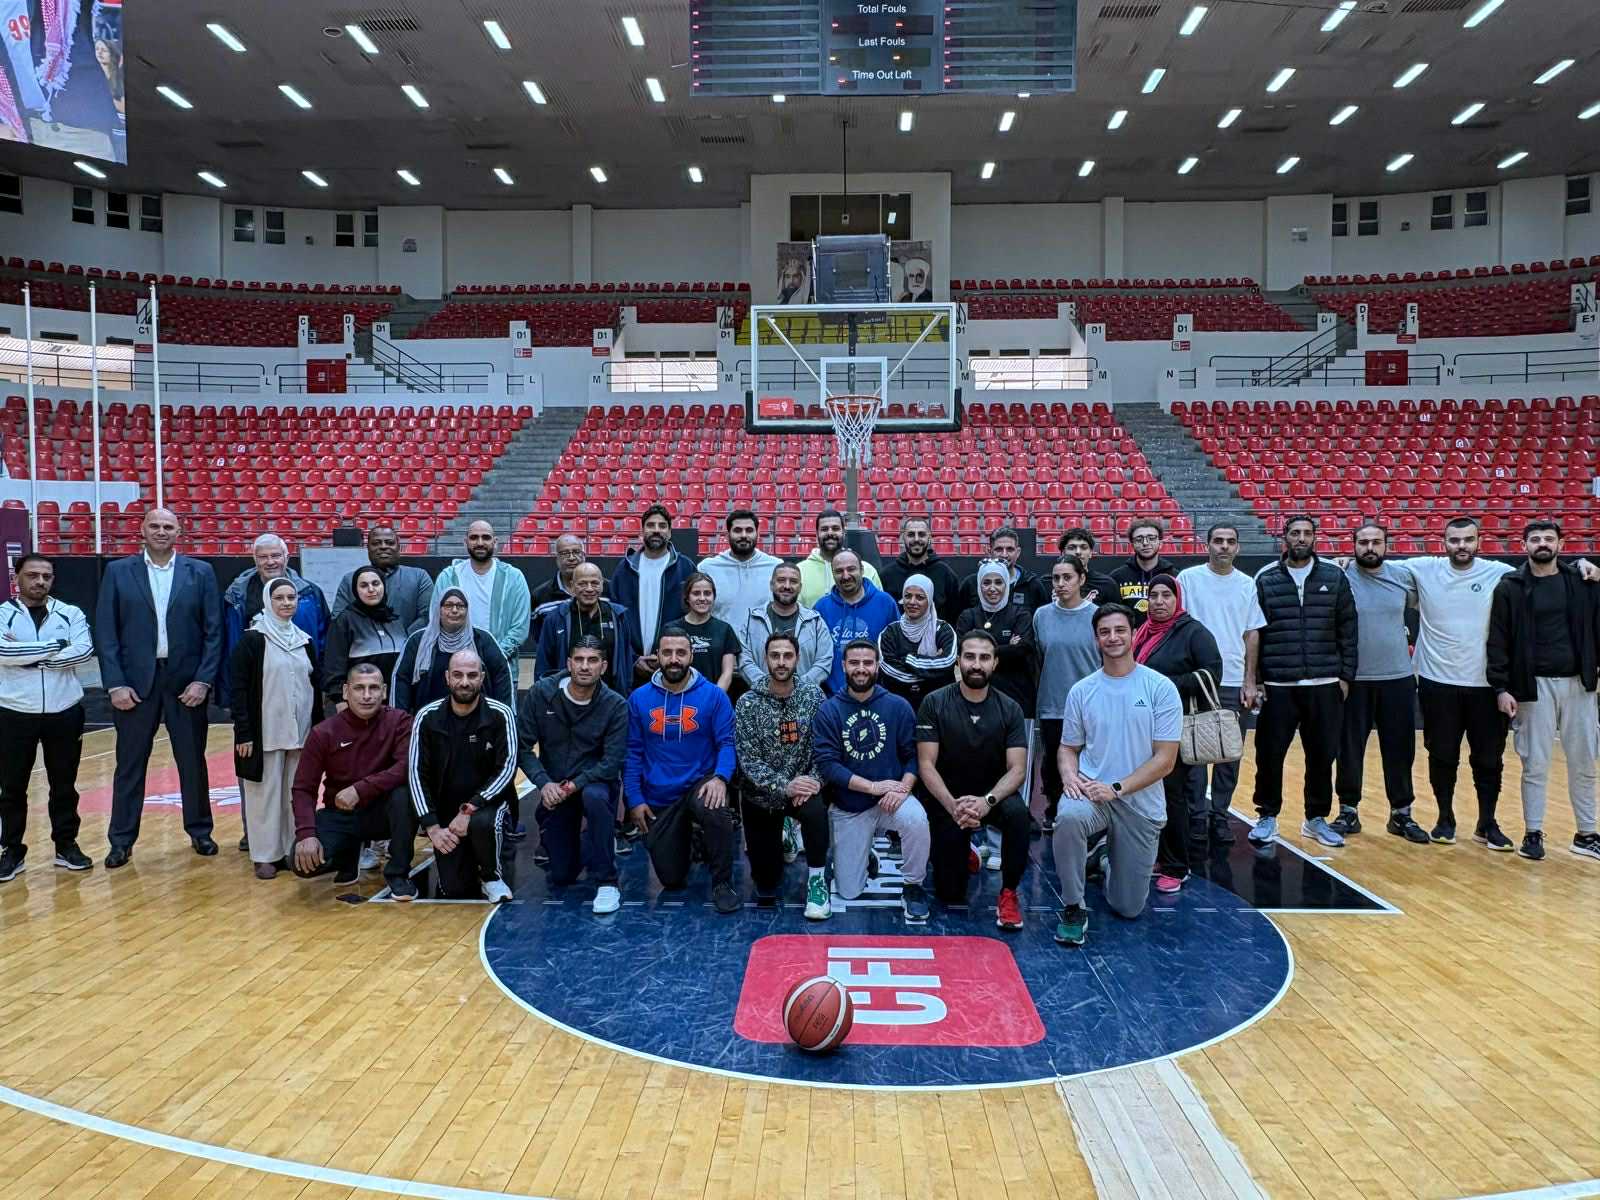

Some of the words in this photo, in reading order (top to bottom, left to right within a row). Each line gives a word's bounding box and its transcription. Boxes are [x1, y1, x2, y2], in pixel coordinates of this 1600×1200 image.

[857, 4, 879, 13] Total
[881, 4, 907, 13] Fouls
[858, 37, 878, 47] Last
[880, 37, 906, 46] Fouls
[851, 70, 874, 80] Time
[876, 70, 893, 79] Out
[895, 70, 913, 79] Left
[1582, 314, 1596, 323] E1
[138, 326, 149, 335] C1
[376, 324, 386, 332] D1
[1091, 325, 1102, 334] D1
[1177, 324, 1188, 333] D1
[516, 331, 527, 339] D1
[597, 331, 608, 340] D1
[720, 330, 731, 339] D1
[961, 372, 970, 381] M
[1098, 370, 1107, 380] M
[1166, 370, 1174, 378] N
[1447, 368, 1454, 377] N
[529, 375, 536, 384] L
[592, 375, 601, 384] M
[725, 373, 734, 383] M
[875, 741, 884, 753] DO
[828, 947, 947, 1025] CFI
